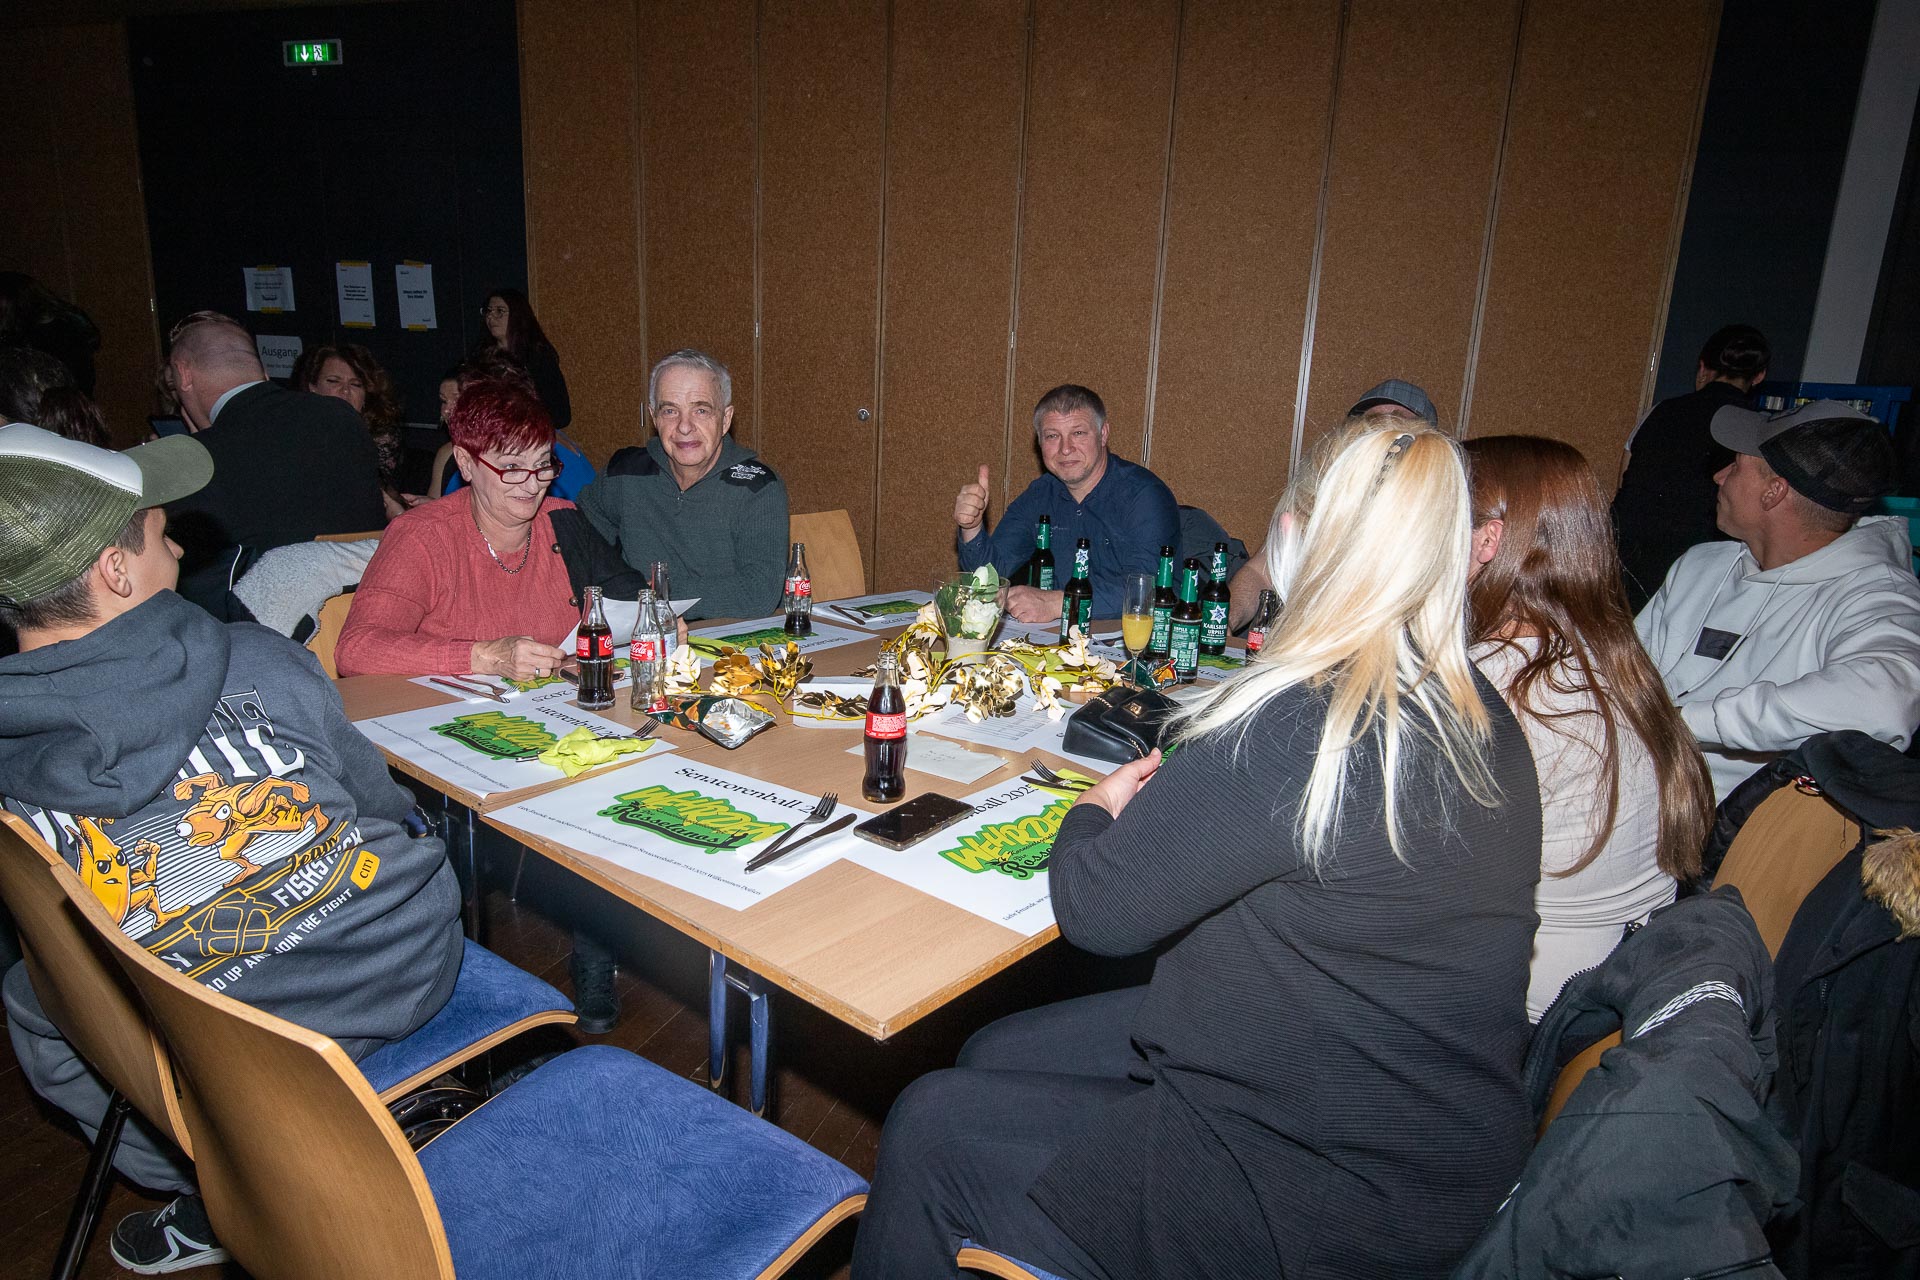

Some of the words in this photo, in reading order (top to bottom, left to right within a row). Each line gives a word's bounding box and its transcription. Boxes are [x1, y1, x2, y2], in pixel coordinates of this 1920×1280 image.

[261, 345, 299, 361] Ausgang
[674, 767, 804, 809] Senatorenball
[359, 856, 374, 880] CITY
[223, 965, 243, 982] UP
[274, 931, 303, 955] JOIN
[296, 913, 322, 934] THE
[320, 888, 353, 919] FIGHT
